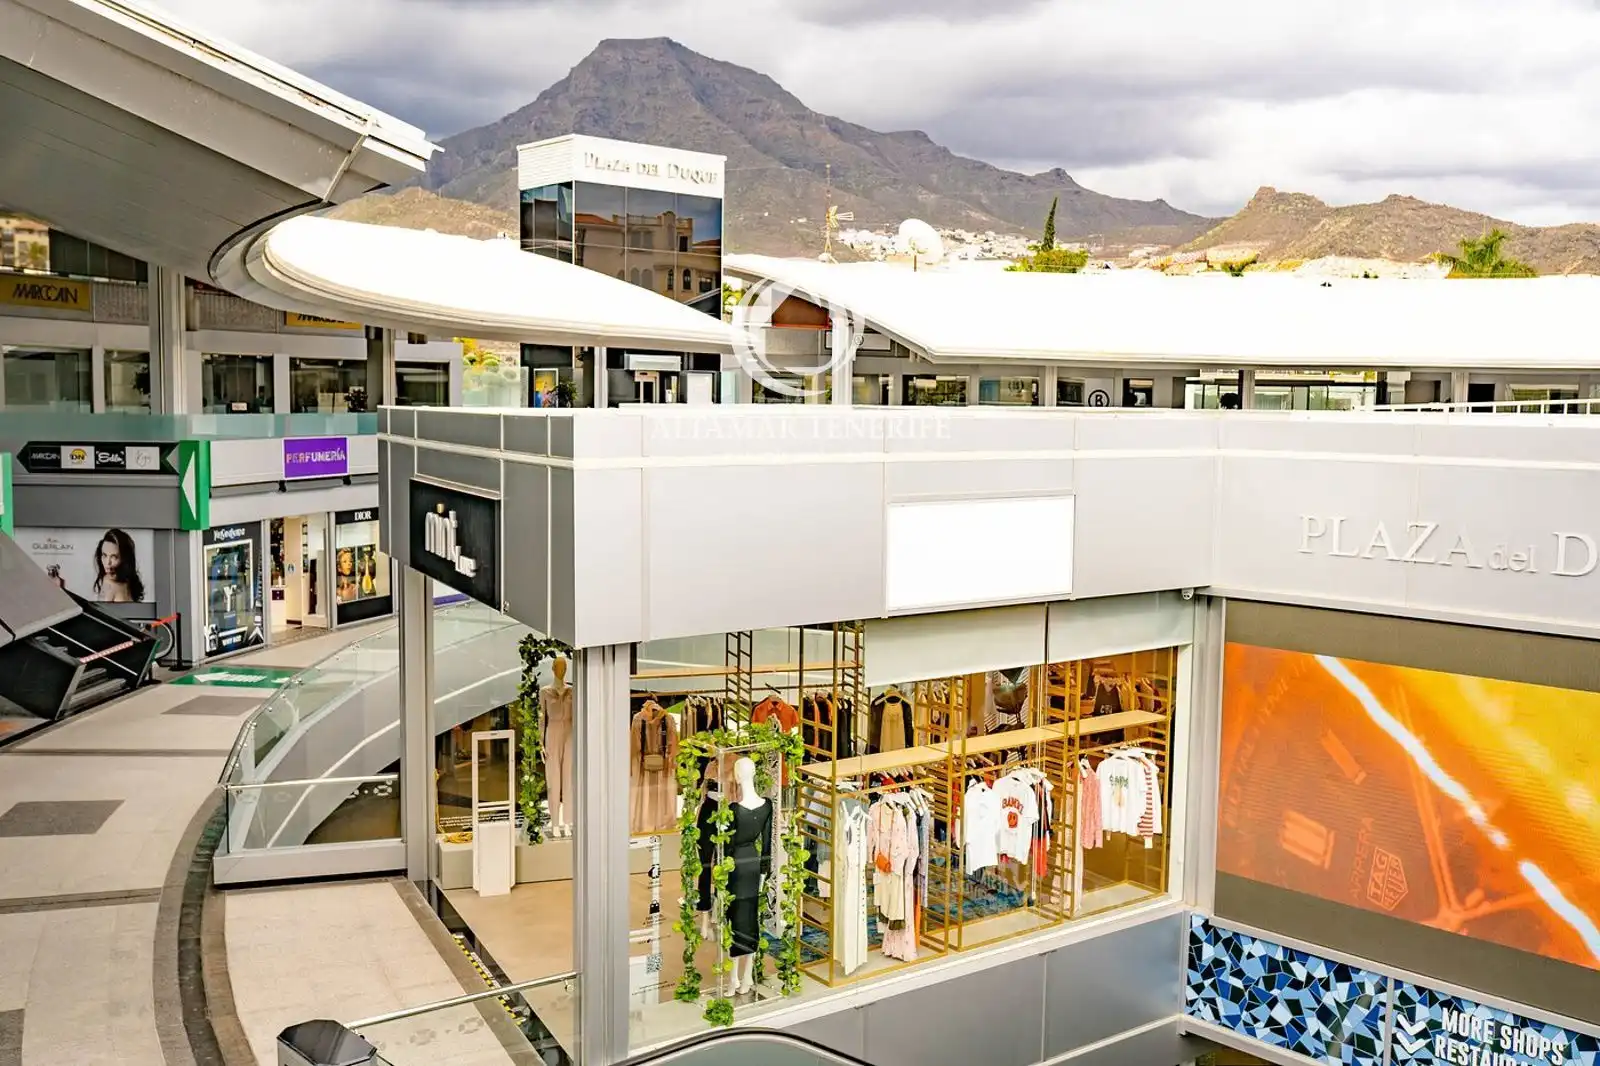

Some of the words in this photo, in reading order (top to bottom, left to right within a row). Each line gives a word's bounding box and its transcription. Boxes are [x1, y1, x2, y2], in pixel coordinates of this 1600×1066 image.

[286, 447, 346, 464] PERFUMERÍA
[354, 510, 371, 521] DIOR
[1298, 515, 1482, 569] PLAZA
[1488, 544, 1538, 574] del
[1371, 852, 1388, 898] TAG
[1441, 1007, 1495, 1045] MORE
[1500, 1025, 1564, 1066] SHOPS
